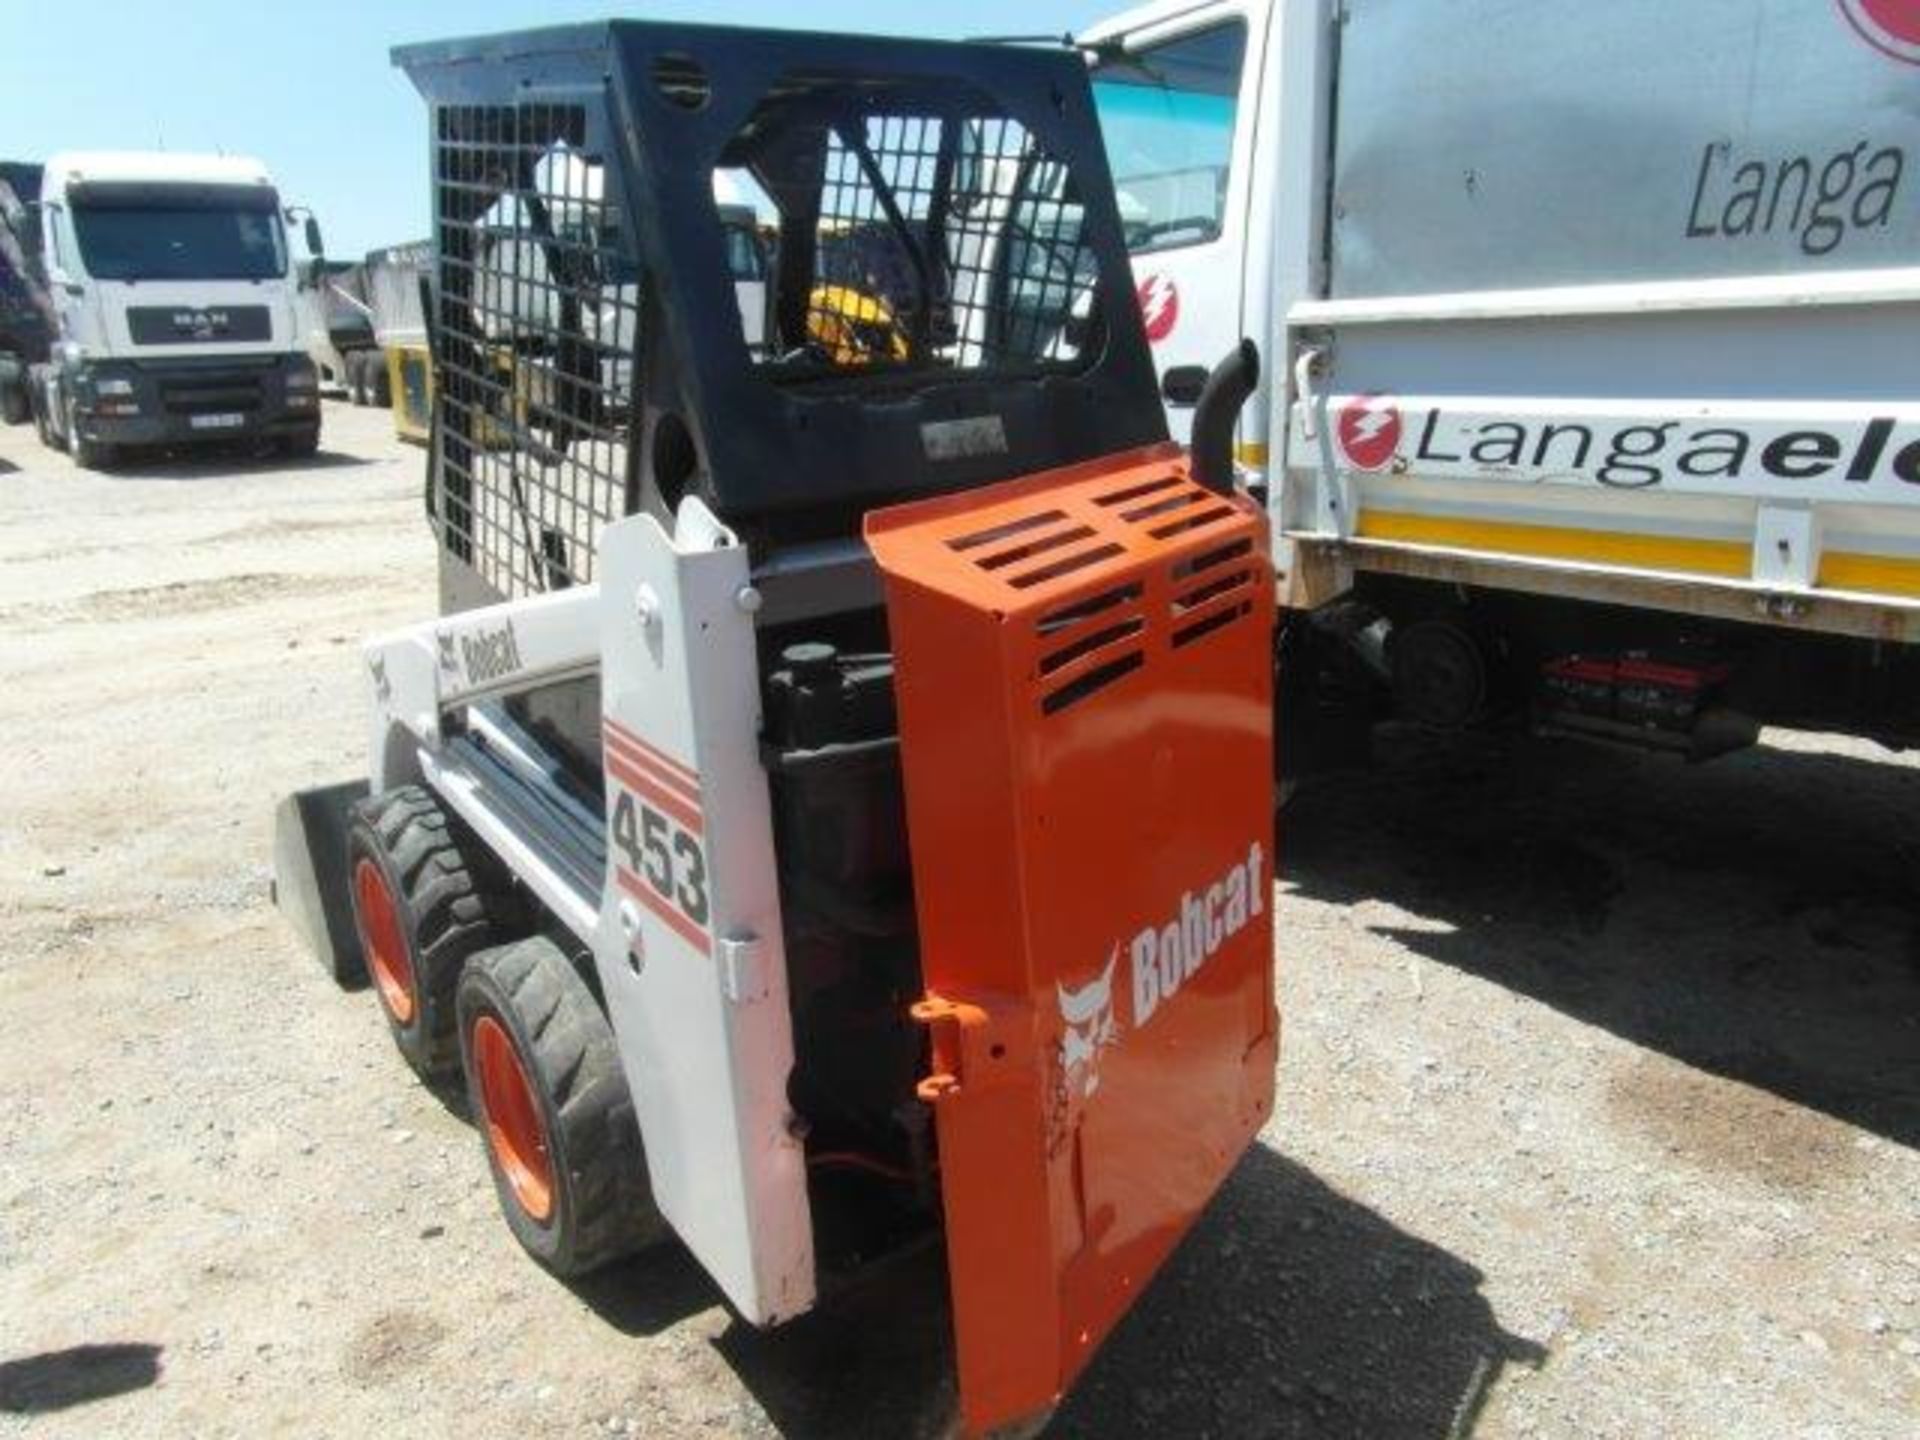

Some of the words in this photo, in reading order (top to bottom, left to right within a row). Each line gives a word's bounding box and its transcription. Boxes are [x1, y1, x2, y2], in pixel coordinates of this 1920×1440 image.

[1686, 141, 1905, 256] Langa
[460, 616, 522, 684] Bobcat
[612, 790, 709, 926] 453
[1131, 840, 1263, 1028] Bobcat
